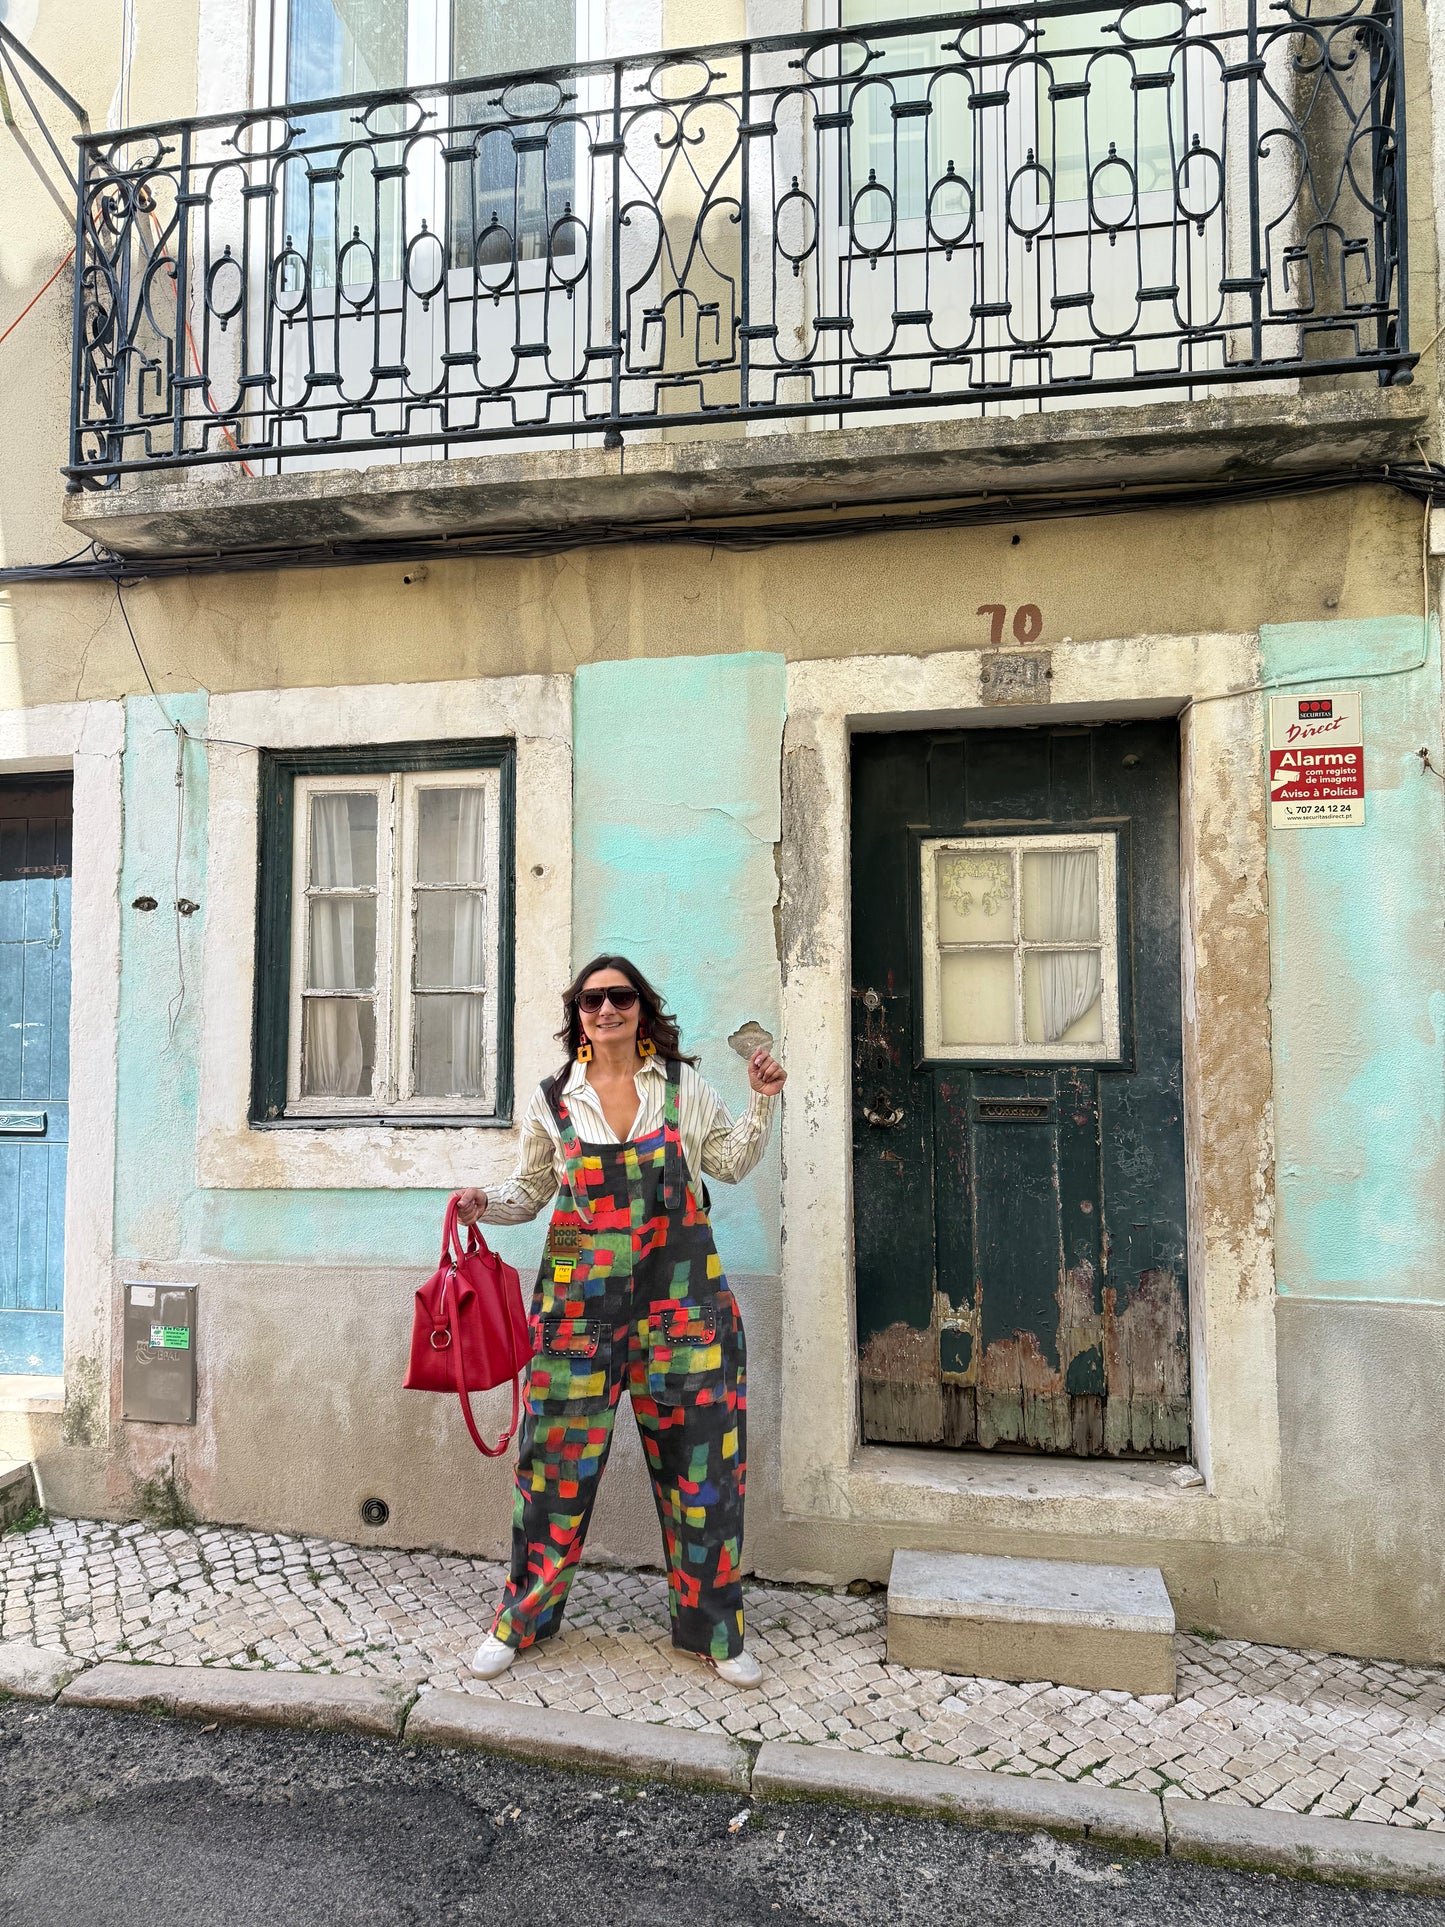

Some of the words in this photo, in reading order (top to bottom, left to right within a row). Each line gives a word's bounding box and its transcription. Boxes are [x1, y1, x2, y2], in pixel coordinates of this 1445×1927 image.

[976, 603, 1043, 645] 70
[1286, 716, 1349, 743] Direct
[1280, 751, 1357, 767] Alarme
[1326, 767, 1357, 776] registo
[1305, 776, 1318, 784] de
[1320, 775, 1357, 784] imagens
[1280, 789, 1310, 799] Aviso
[1313, 788, 1320, 797] à
[1323, 787, 1358, 797] Polícia
[1296, 806, 1312, 814] 707
[1314, 805, 1326, 813] 24
[1328, 805, 1338, 813] 12
[1340, 804, 1351, 812] 24
[1287, 813, 1353, 821] www.securitasdirect.pt
[554, 1237, 577, 1246] LUCK
